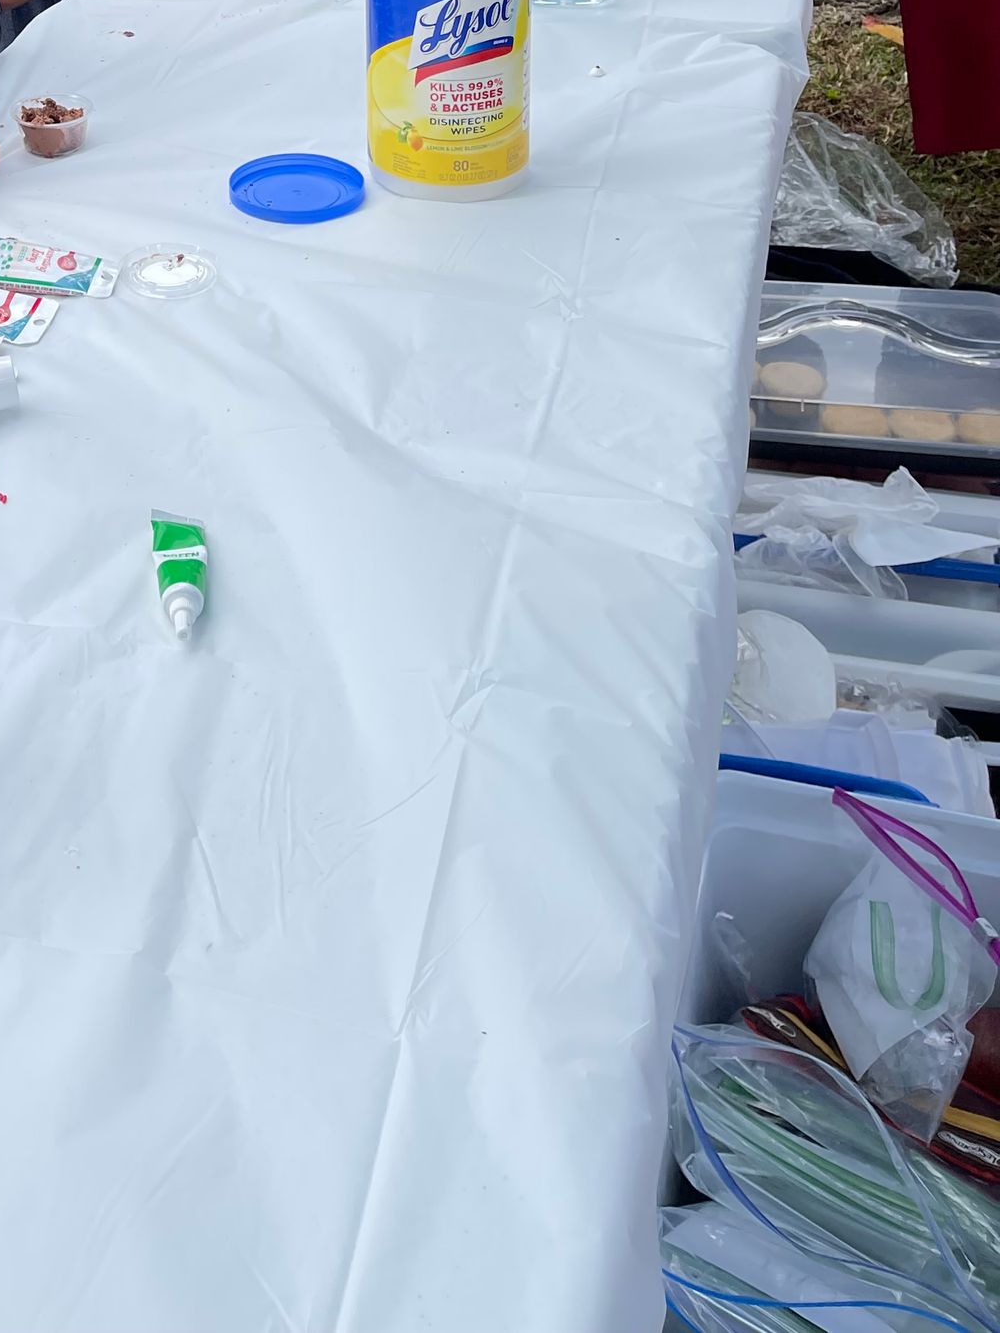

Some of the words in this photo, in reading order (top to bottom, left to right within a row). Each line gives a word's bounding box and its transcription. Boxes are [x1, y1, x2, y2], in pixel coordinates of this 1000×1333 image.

[430, 83, 464, 92] KILLS
[468, 78, 503, 91] 99.9%
[430, 93, 446, 102] OF
[451, 87, 503, 102] VIRUSES
[430, 103, 438, 112] &
[442, 98, 503, 112] BACTERIA
[429, 112, 504, 126] DISINFECTING
[451, 126, 486, 135] WIPES
[453, 160, 469, 171] 80
